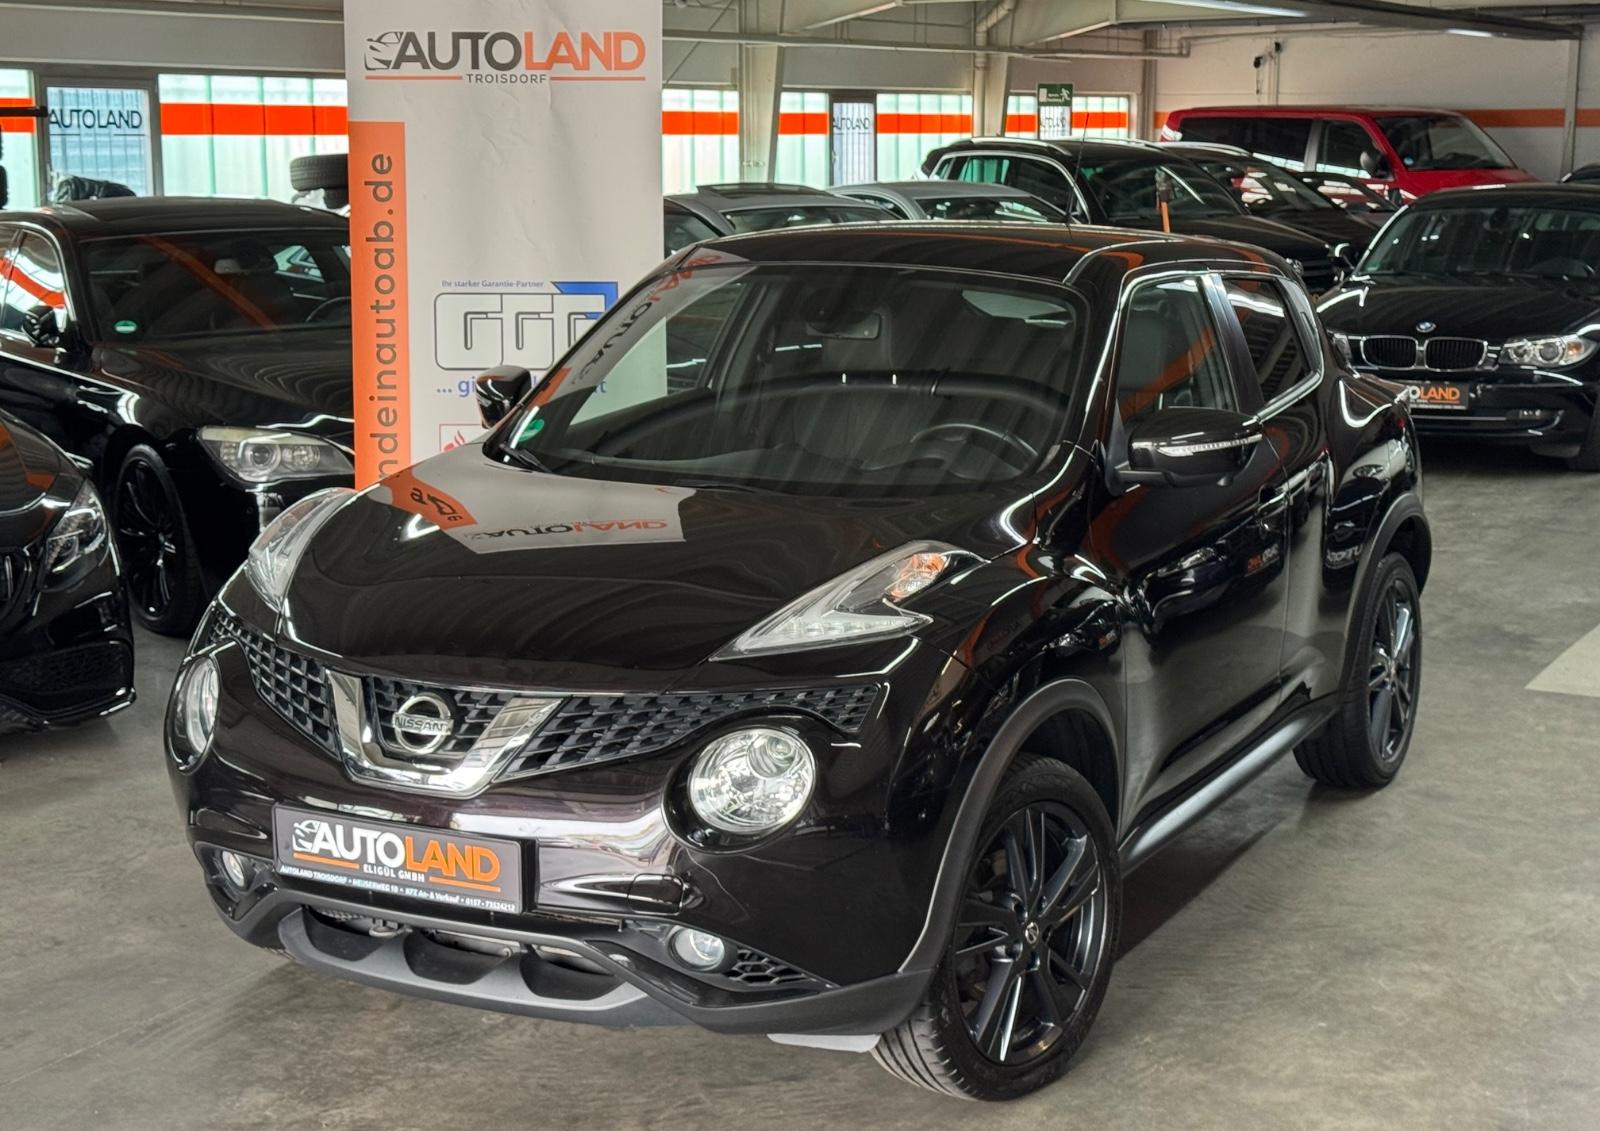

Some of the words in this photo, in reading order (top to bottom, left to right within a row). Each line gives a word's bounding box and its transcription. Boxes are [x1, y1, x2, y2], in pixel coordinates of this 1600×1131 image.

[390, 31, 646, 71] AUTOLAND
[467, 73, 547, 84] TROISDORF
[49, 109, 143, 129] AUTOLAND
[441, 280, 453, 288] Ihr
[454, 280, 480, 288] starker
[481, 280, 544, 288] Garantie-Partner
[364, 153, 398, 479] ndeinautoab.de
[1408, 385, 1460, 400] OLAND
[395, 716, 443, 732] NISSAN
[310, 820, 500, 883] AUTOLAND
[280, 865, 313, 878] AUTOLAND
[398, 870, 425, 883] GMBH
